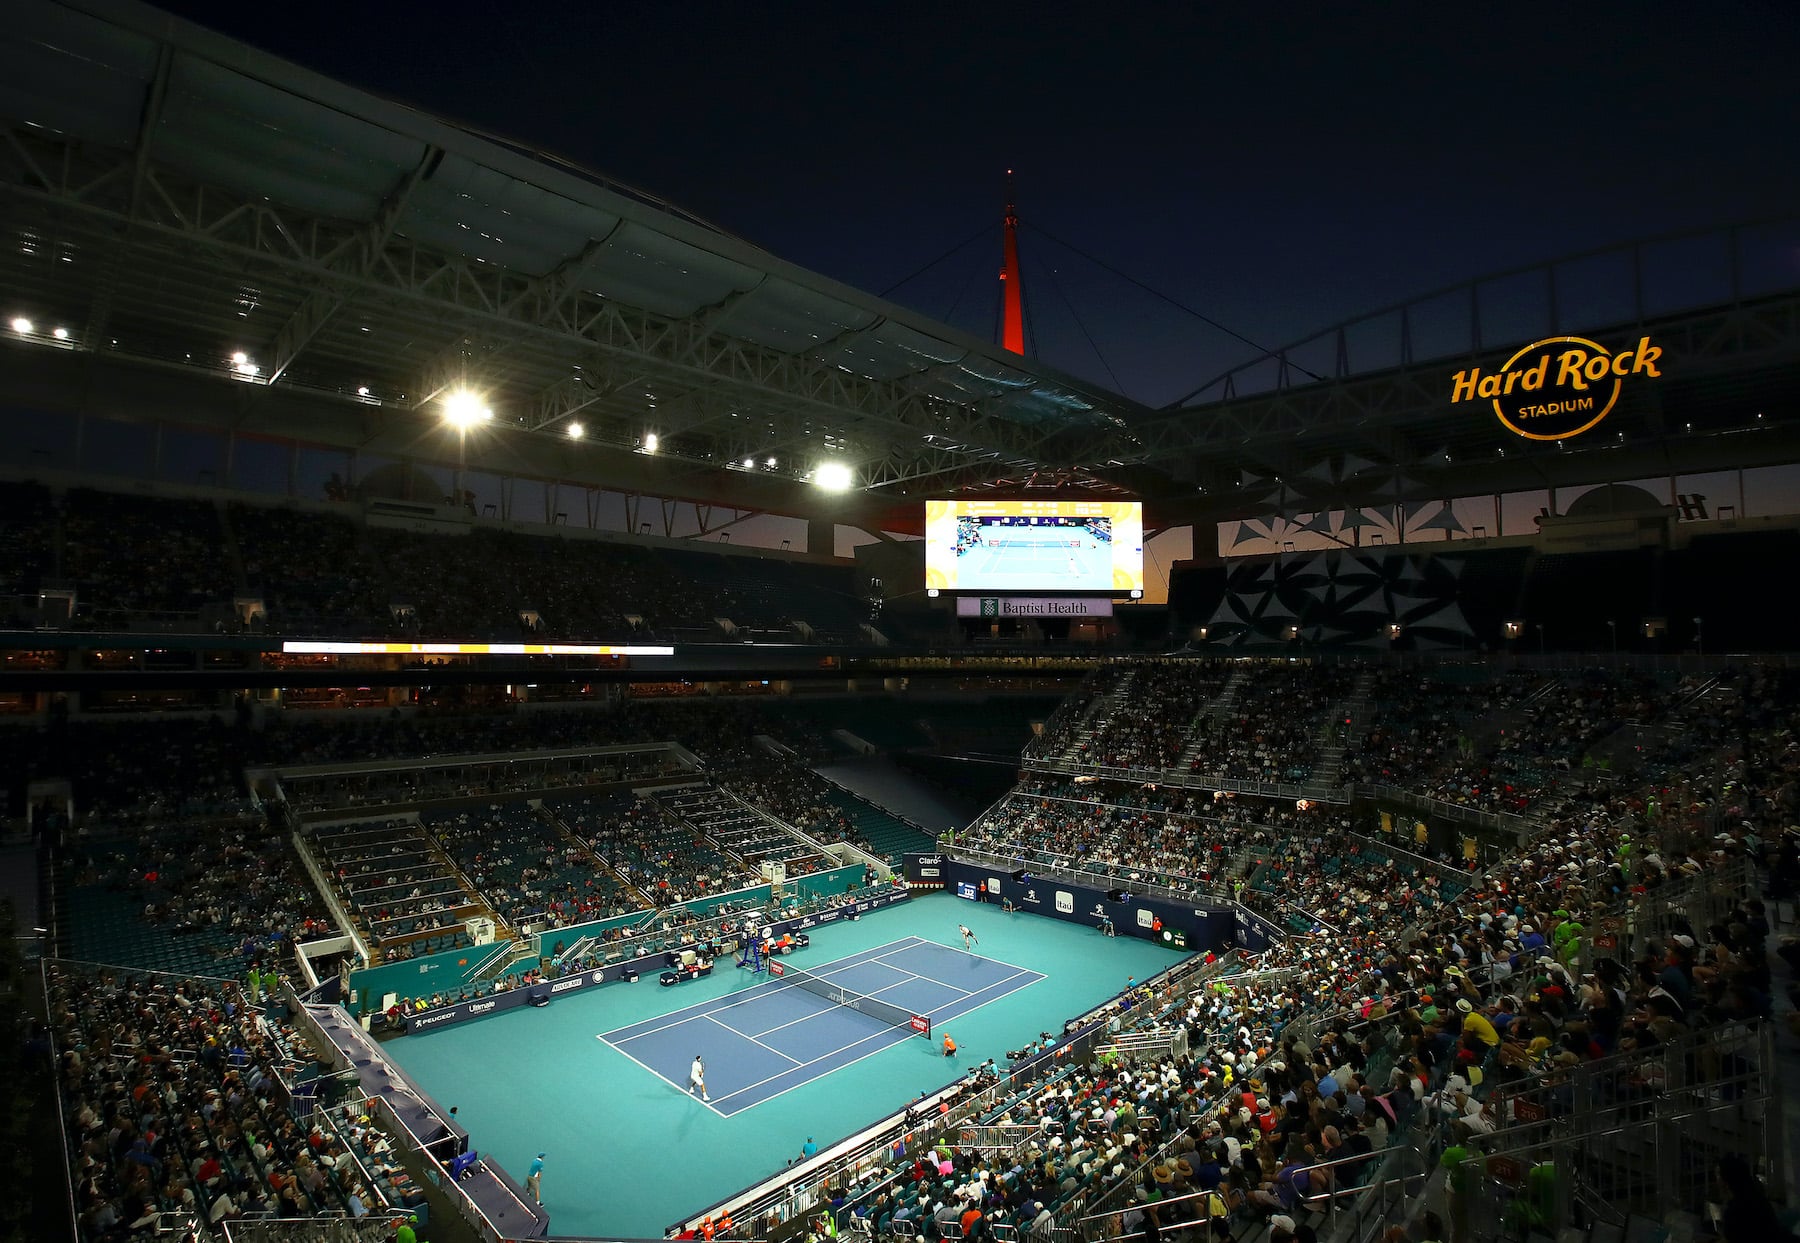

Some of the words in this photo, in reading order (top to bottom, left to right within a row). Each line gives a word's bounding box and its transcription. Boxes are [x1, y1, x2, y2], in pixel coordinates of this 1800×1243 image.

[1451, 354, 1550, 403] Hard
[1556, 336, 1663, 391] Rock
[1518, 397, 1593, 419] STADIUM
[1003, 603, 1044, 617] Baptist
[1047, 603, 1087, 615] Health
[918, 855, 943, 865] Claro
[422, 1012, 456, 1024] PEUGEOT
